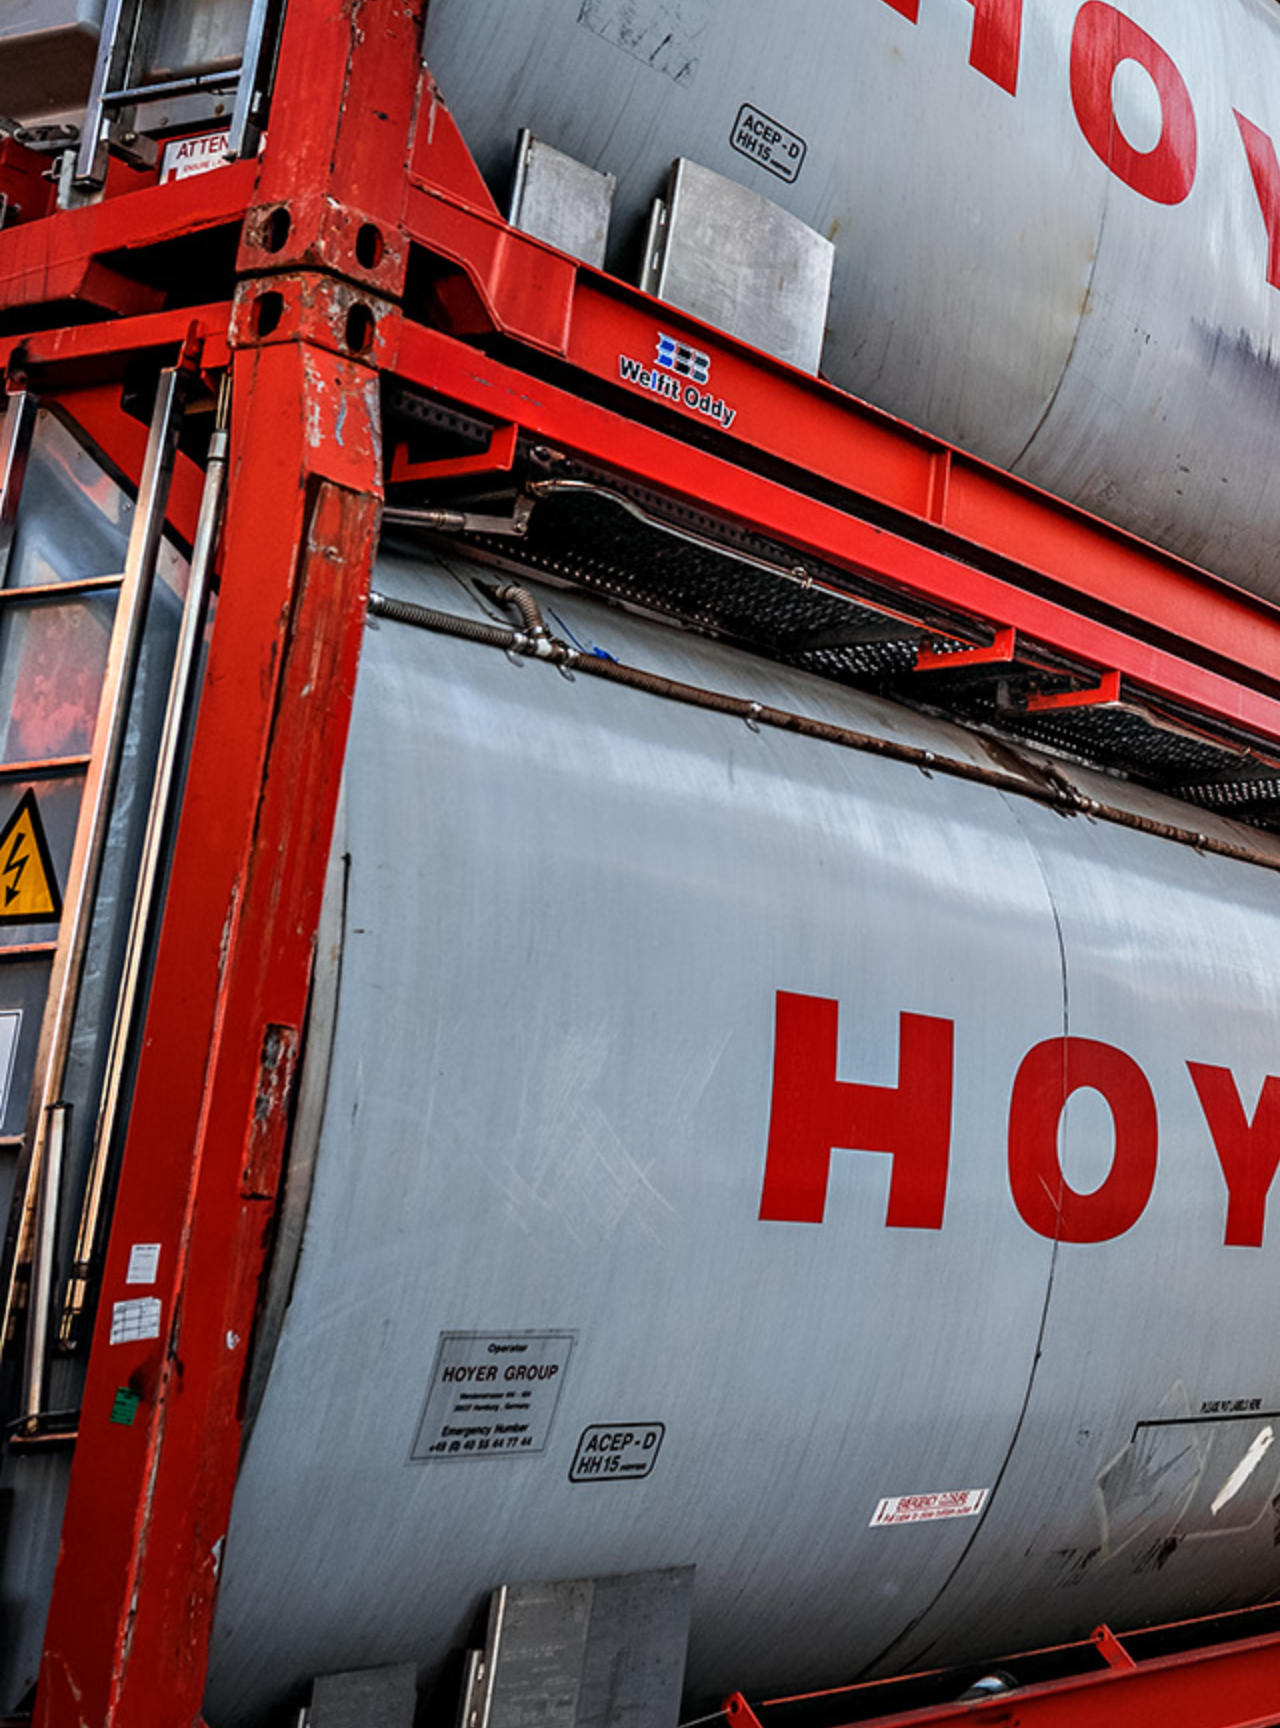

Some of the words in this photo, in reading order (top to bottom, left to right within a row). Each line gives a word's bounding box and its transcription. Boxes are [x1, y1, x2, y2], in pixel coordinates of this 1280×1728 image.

[619, 354, 681, 402] Welfit
[684, 386, 736, 427] Oddy
[487, 1344, 528, 1354] Operator
[442, 1366, 498, 1382] HOYER
[504, 1365, 559, 1381] GROUP
[442, 1426, 492, 1438] Emergency
[495, 1424, 529, 1434] Number
